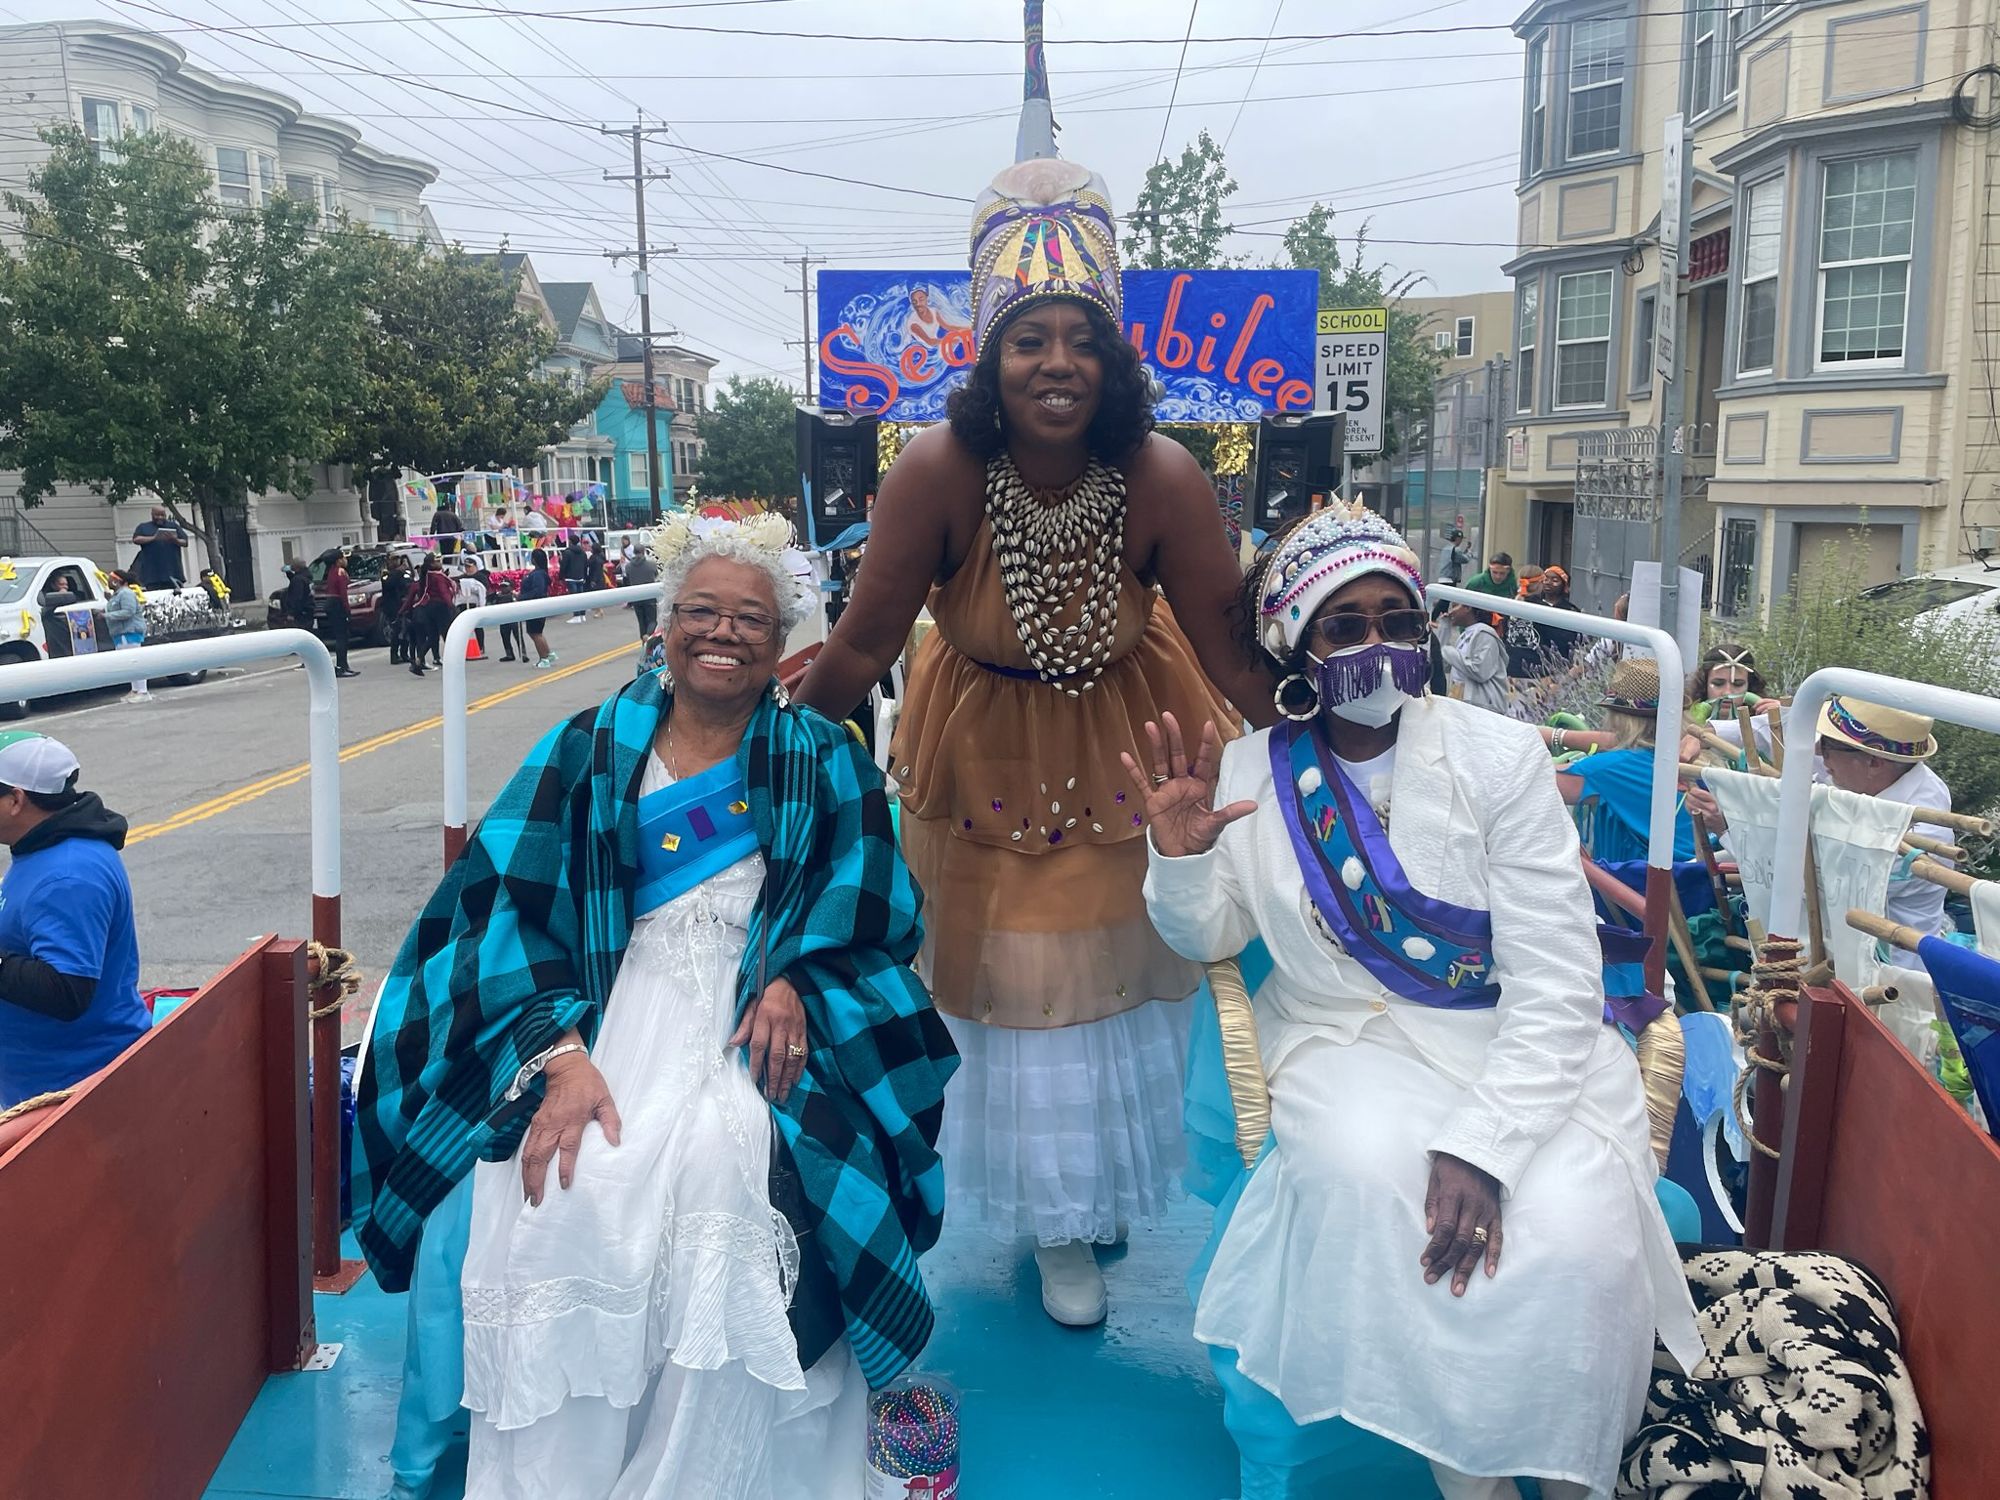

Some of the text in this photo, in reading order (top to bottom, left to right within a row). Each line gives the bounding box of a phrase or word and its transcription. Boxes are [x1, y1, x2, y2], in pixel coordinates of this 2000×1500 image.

[1320, 314, 1382, 329] SCHOOL
[820, 273, 1313, 416] Sea ubilee
[1321, 343, 1380, 358] SPEED
[1326, 362, 1373, 376] LIMIT
[1327, 380, 1370, 412] 15
[1344, 434, 1375, 442] RESENT
[1345, 427, 1367, 435] DREN
